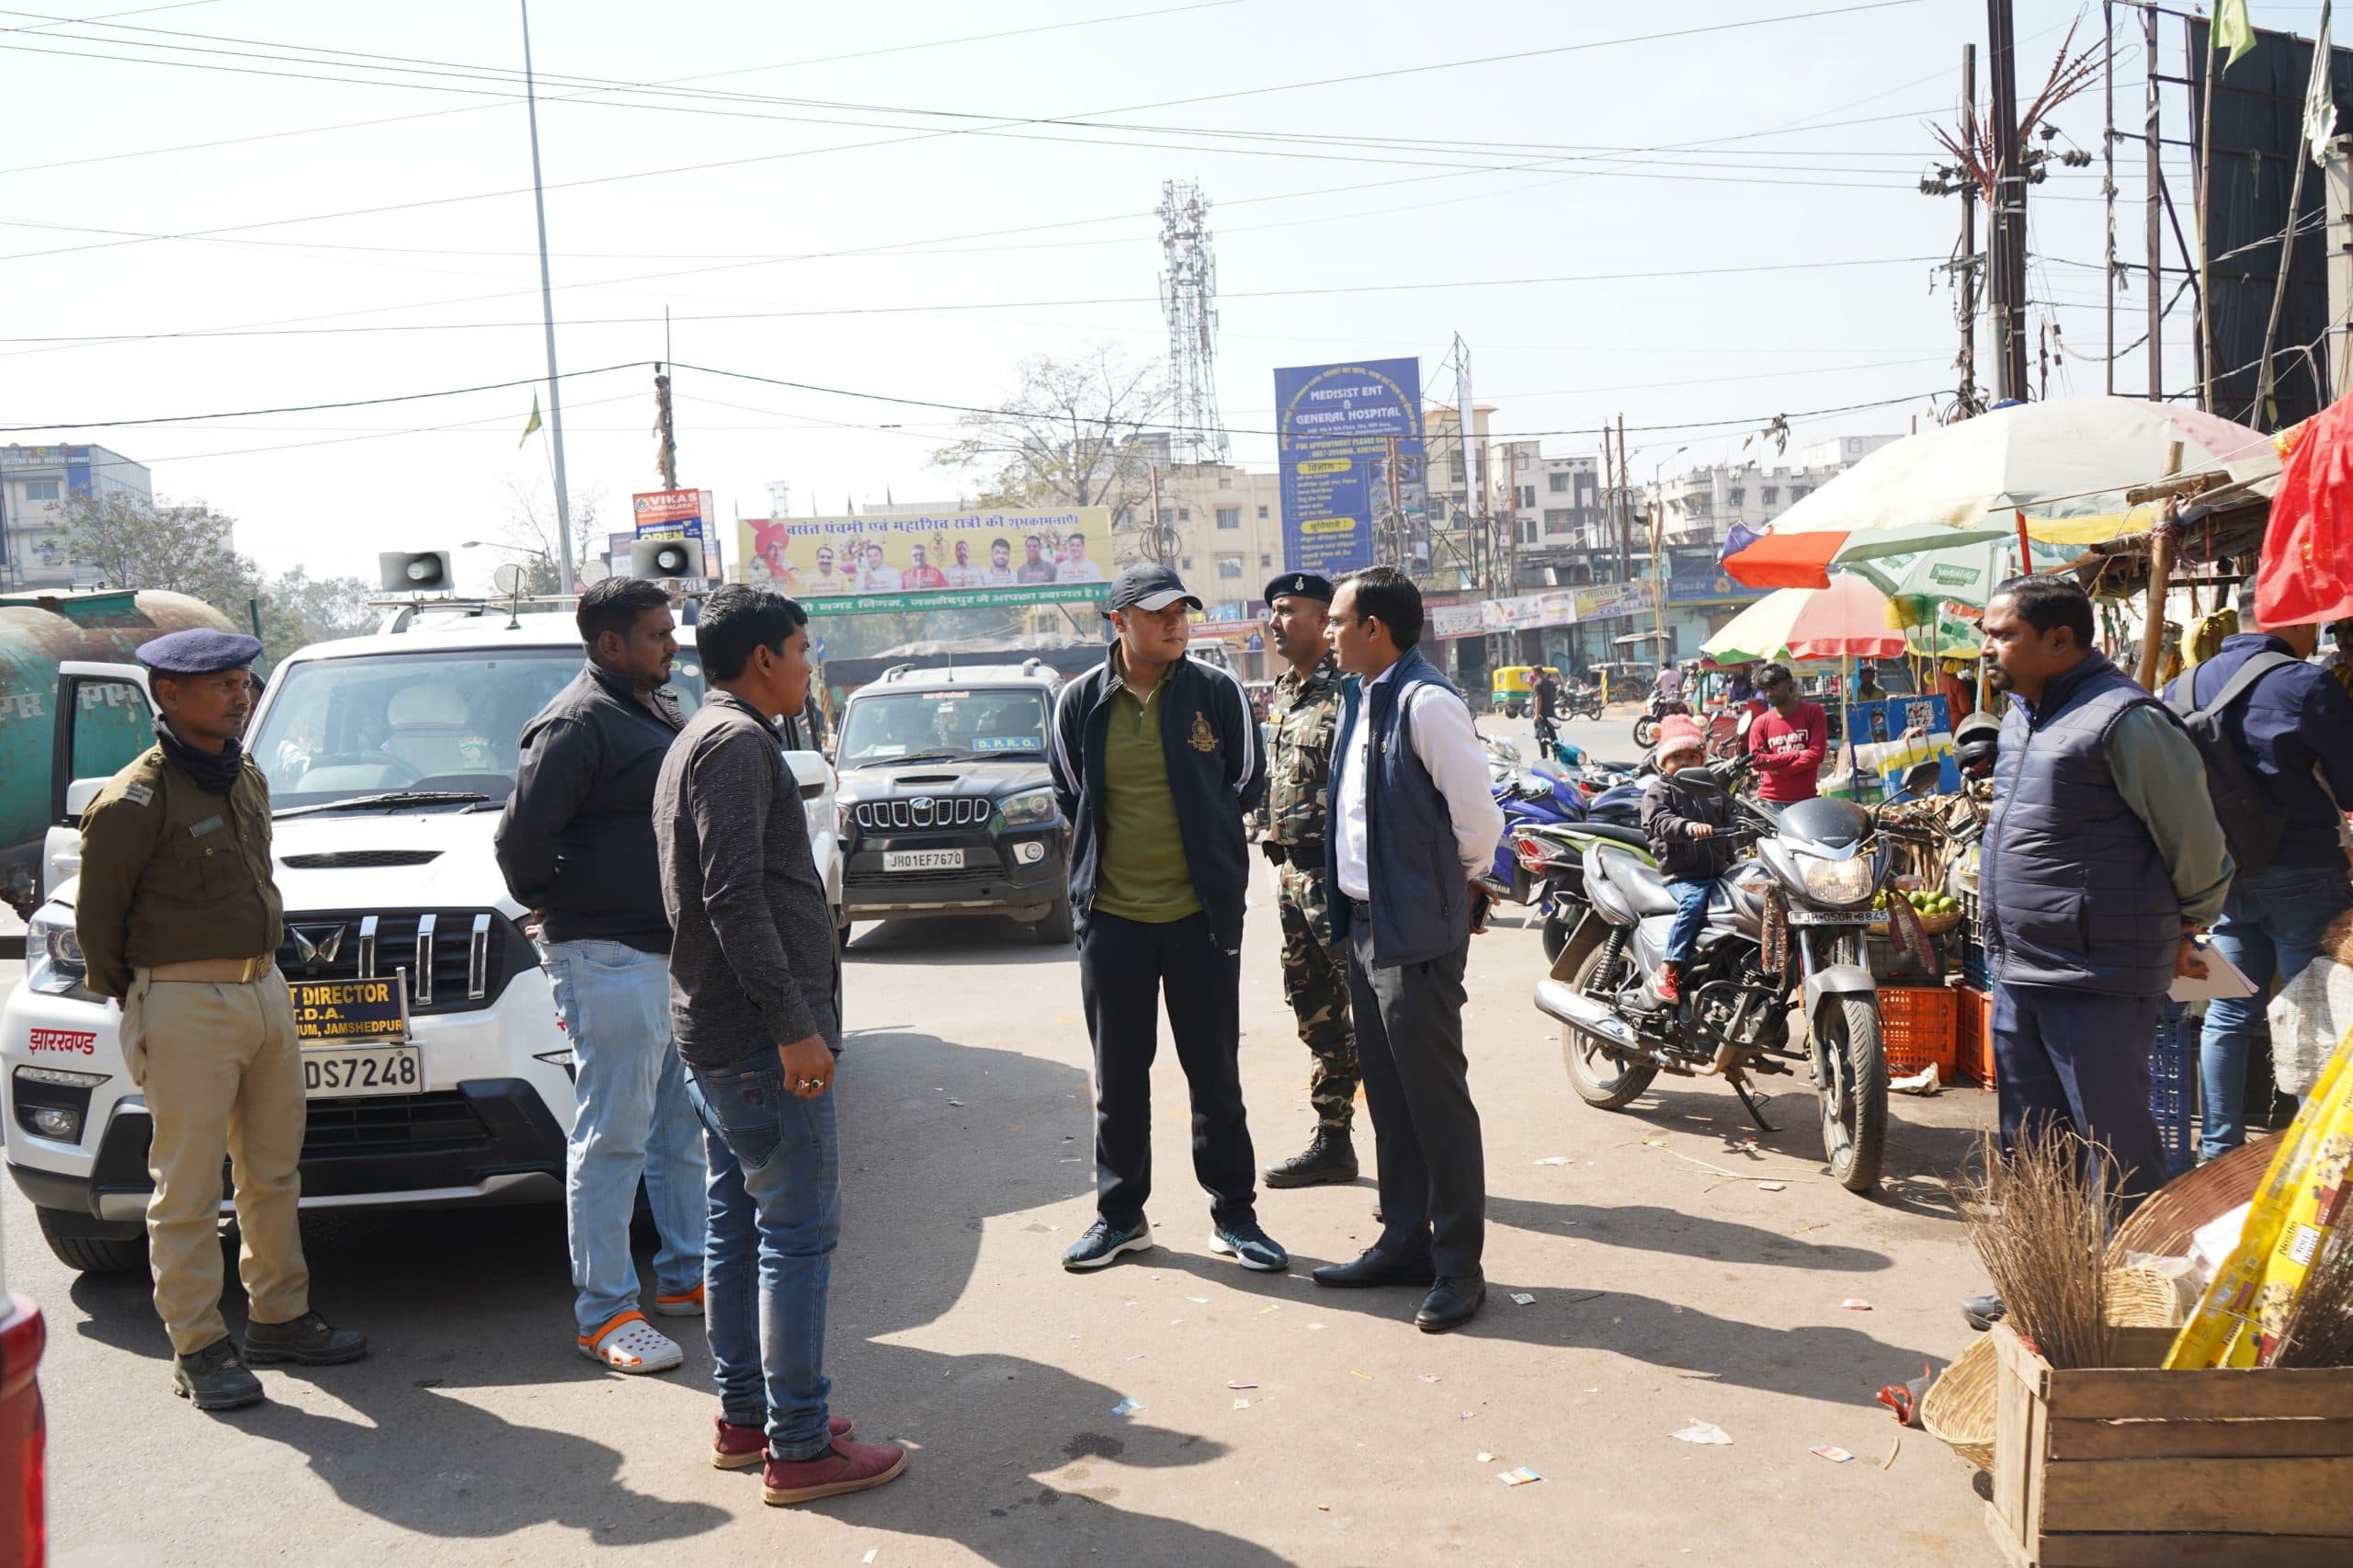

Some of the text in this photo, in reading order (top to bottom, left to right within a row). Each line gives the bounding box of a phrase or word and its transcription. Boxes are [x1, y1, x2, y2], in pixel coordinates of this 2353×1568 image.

[1311, 385, 1383, 401] MEDISIST ENT
[1296, 406, 1402, 425] GENERAL HOSPITAL
[650, 493, 697, 506] VIKAS
[787, 522, 820, 535] वसंत
[869, 519, 888, 531] एवं
[893, 517, 948, 533] महाशिव
[986, 515, 1004, 528] की
[640, 531, 685, 540] OPEN
[1905, 700, 1933, 711] PEPSI
[1768, 733, 1805, 749] never
[891, 854, 961, 868] JH01EF7670
[302, 983, 390, 1006] DIRECTOR
[324, 1019, 404, 1035] JAMSHEDPUR
[28, 1028, 97, 1056] झारखण्ड
[304, 1056, 415, 1089] DS7248
